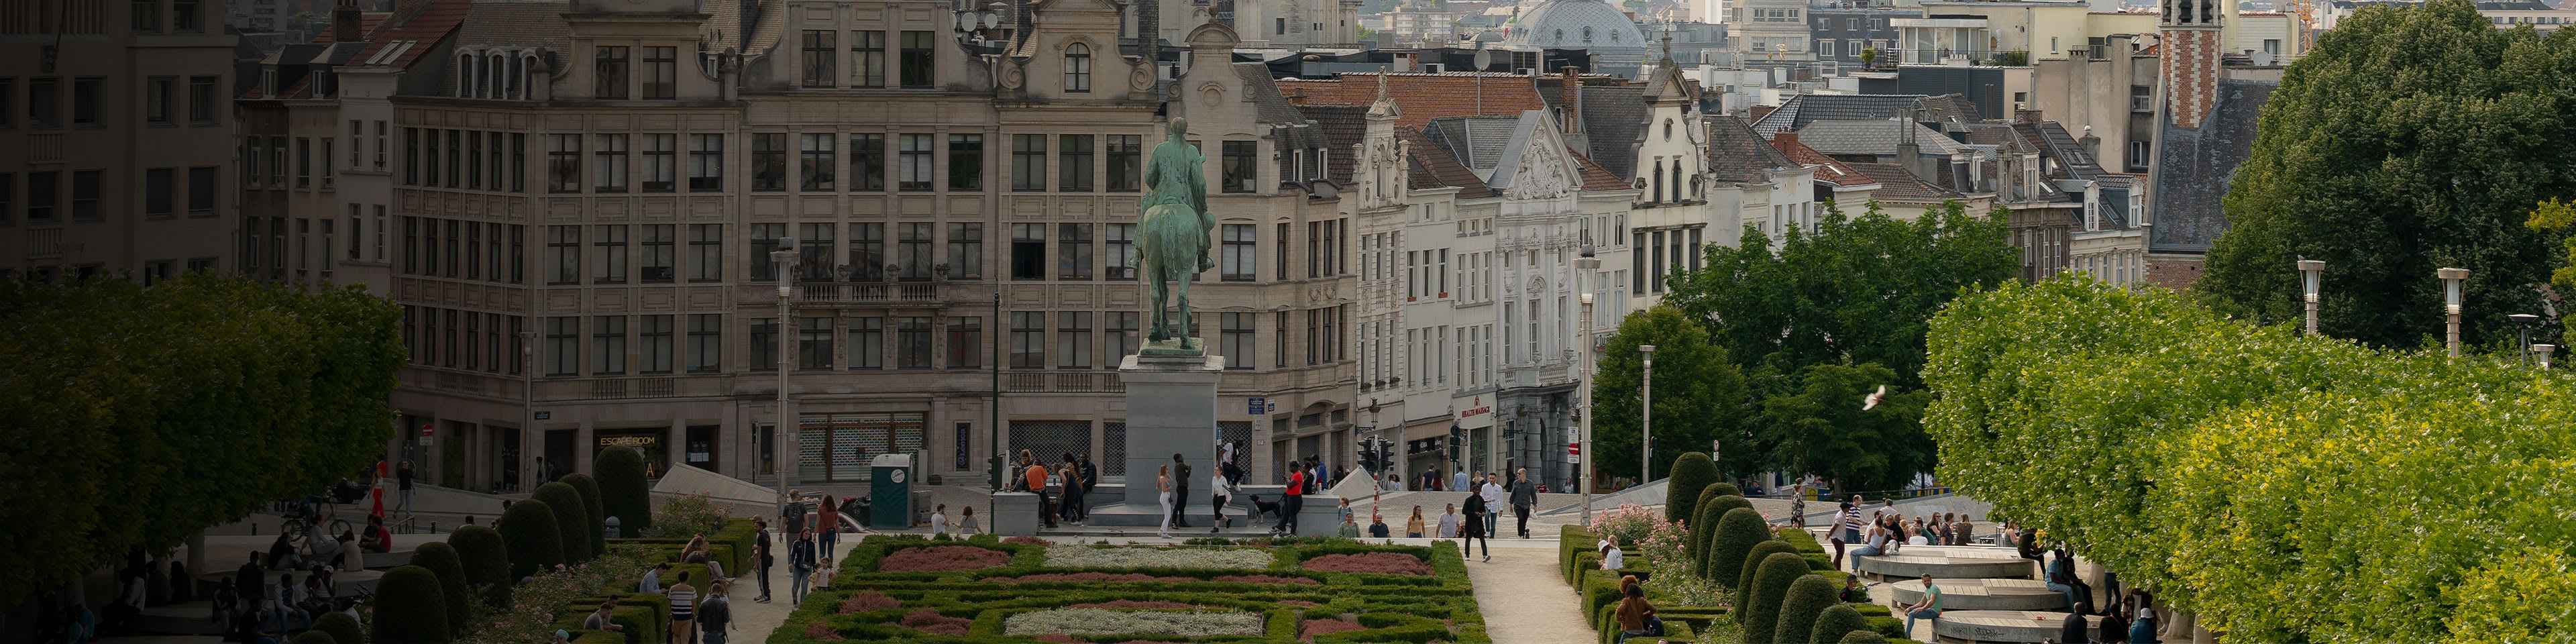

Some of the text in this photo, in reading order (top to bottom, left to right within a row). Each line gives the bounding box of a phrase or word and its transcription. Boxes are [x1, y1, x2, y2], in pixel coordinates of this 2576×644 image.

[1462, 406, 1491, 418] HEALTH MASSAGE
[600, 437, 655, 445] ESCAPE ROOM
